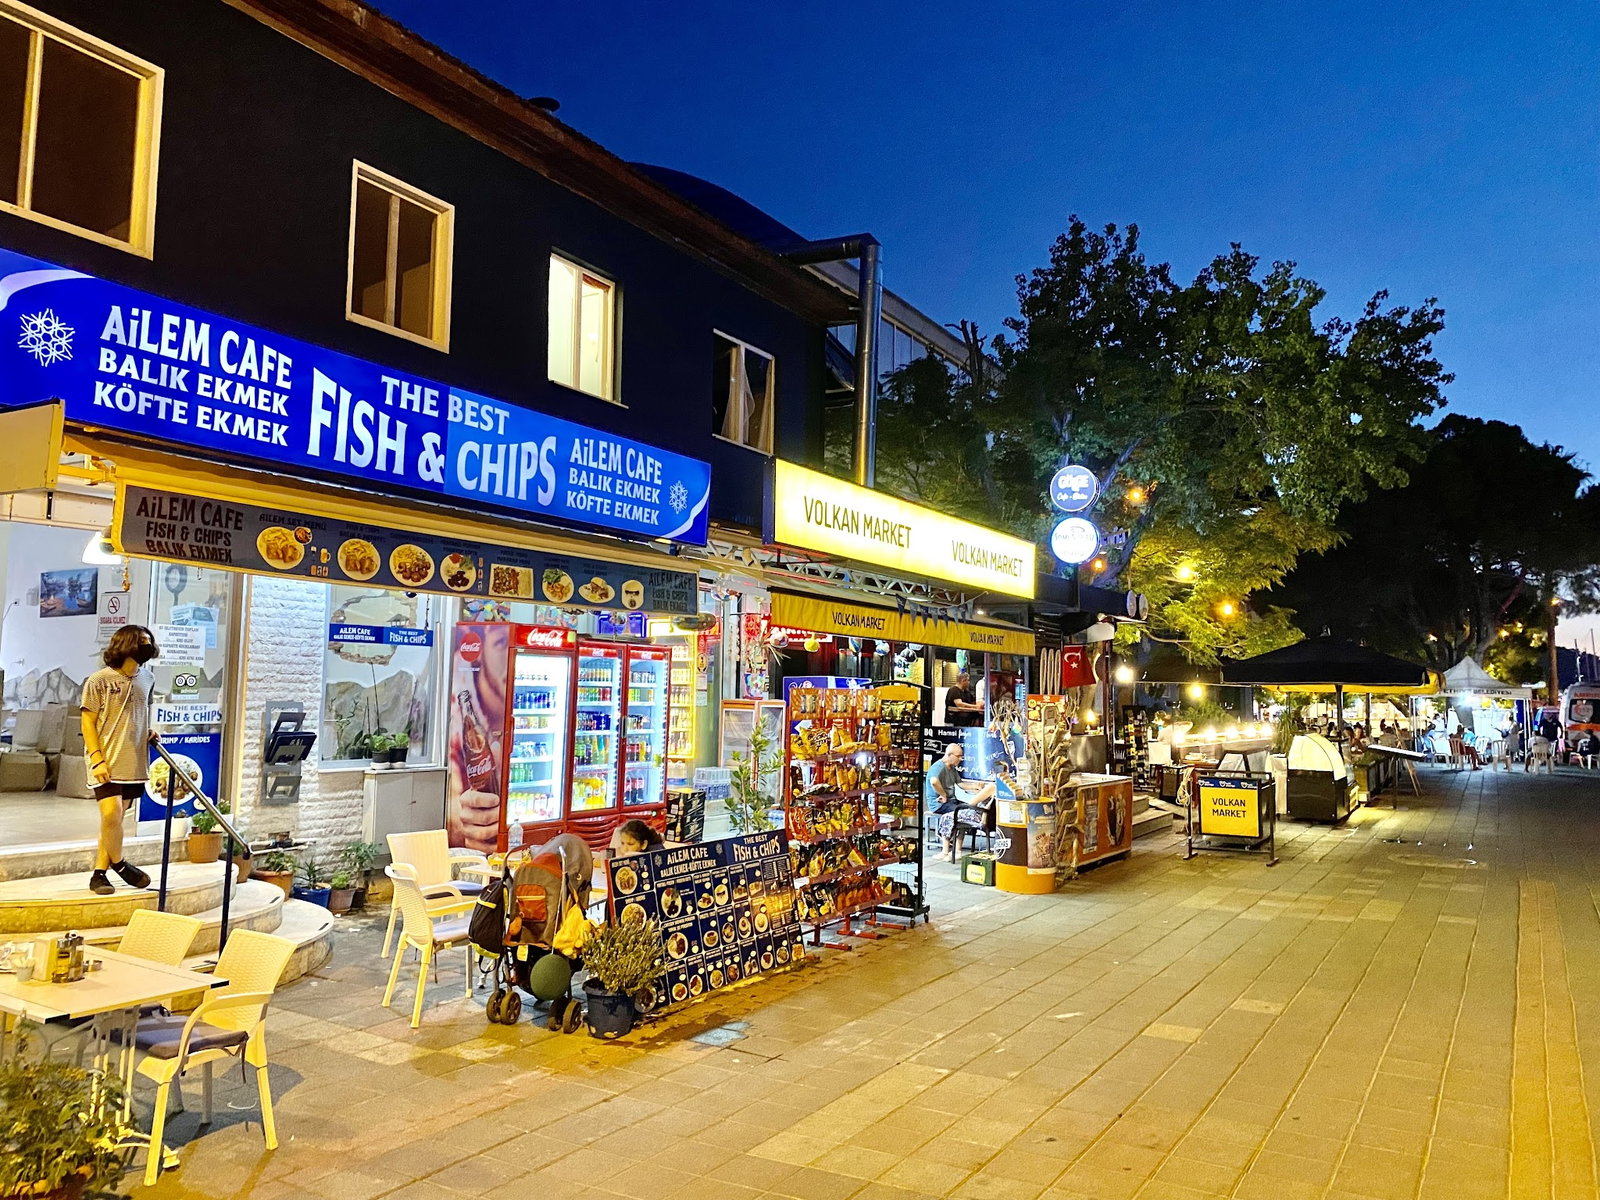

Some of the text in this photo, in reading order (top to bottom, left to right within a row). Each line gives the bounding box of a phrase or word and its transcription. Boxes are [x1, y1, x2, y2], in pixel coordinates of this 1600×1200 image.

[219, 330, 293, 389] CAFE
[98, 347, 288, 417] BALIK EKMEK
[93, 380, 288, 446] KÖFTE EKMEK
[381, 374, 510, 435] THE BEST
[307, 367, 557, 507] FISH & CHIPS
[626, 448, 662, 485] CAFE
[569, 467, 661, 504] BALIK EKMEK
[200, 501, 244, 531] CAFE
[566, 490, 660, 526] KÖFTE EKMEK
[146, 521, 232, 547] FISH & CHIPS
[804, 496, 912, 549] VOLKAN MARKET
[145, 539, 233, 564] BALIK EKMEK
[951, 539, 1023, 578] VOLKAN MARKET
[674, 574, 693, 590] CAFE
[832, 611, 886, 630] VOLKAN MARKET
[389, 632, 402, 642] FISH
[409, 634, 426, 644] CHIPS
[157, 708, 223, 722] FISH & CHIPS
[1212, 798, 1246, 807] VOLKAN
[1212, 809, 1247, 818] MARKET
[690, 847, 708, 859] CAFE
[733, 835, 780, 862] FISH & CHIPS
[744, 834, 768, 845] THE BEST
